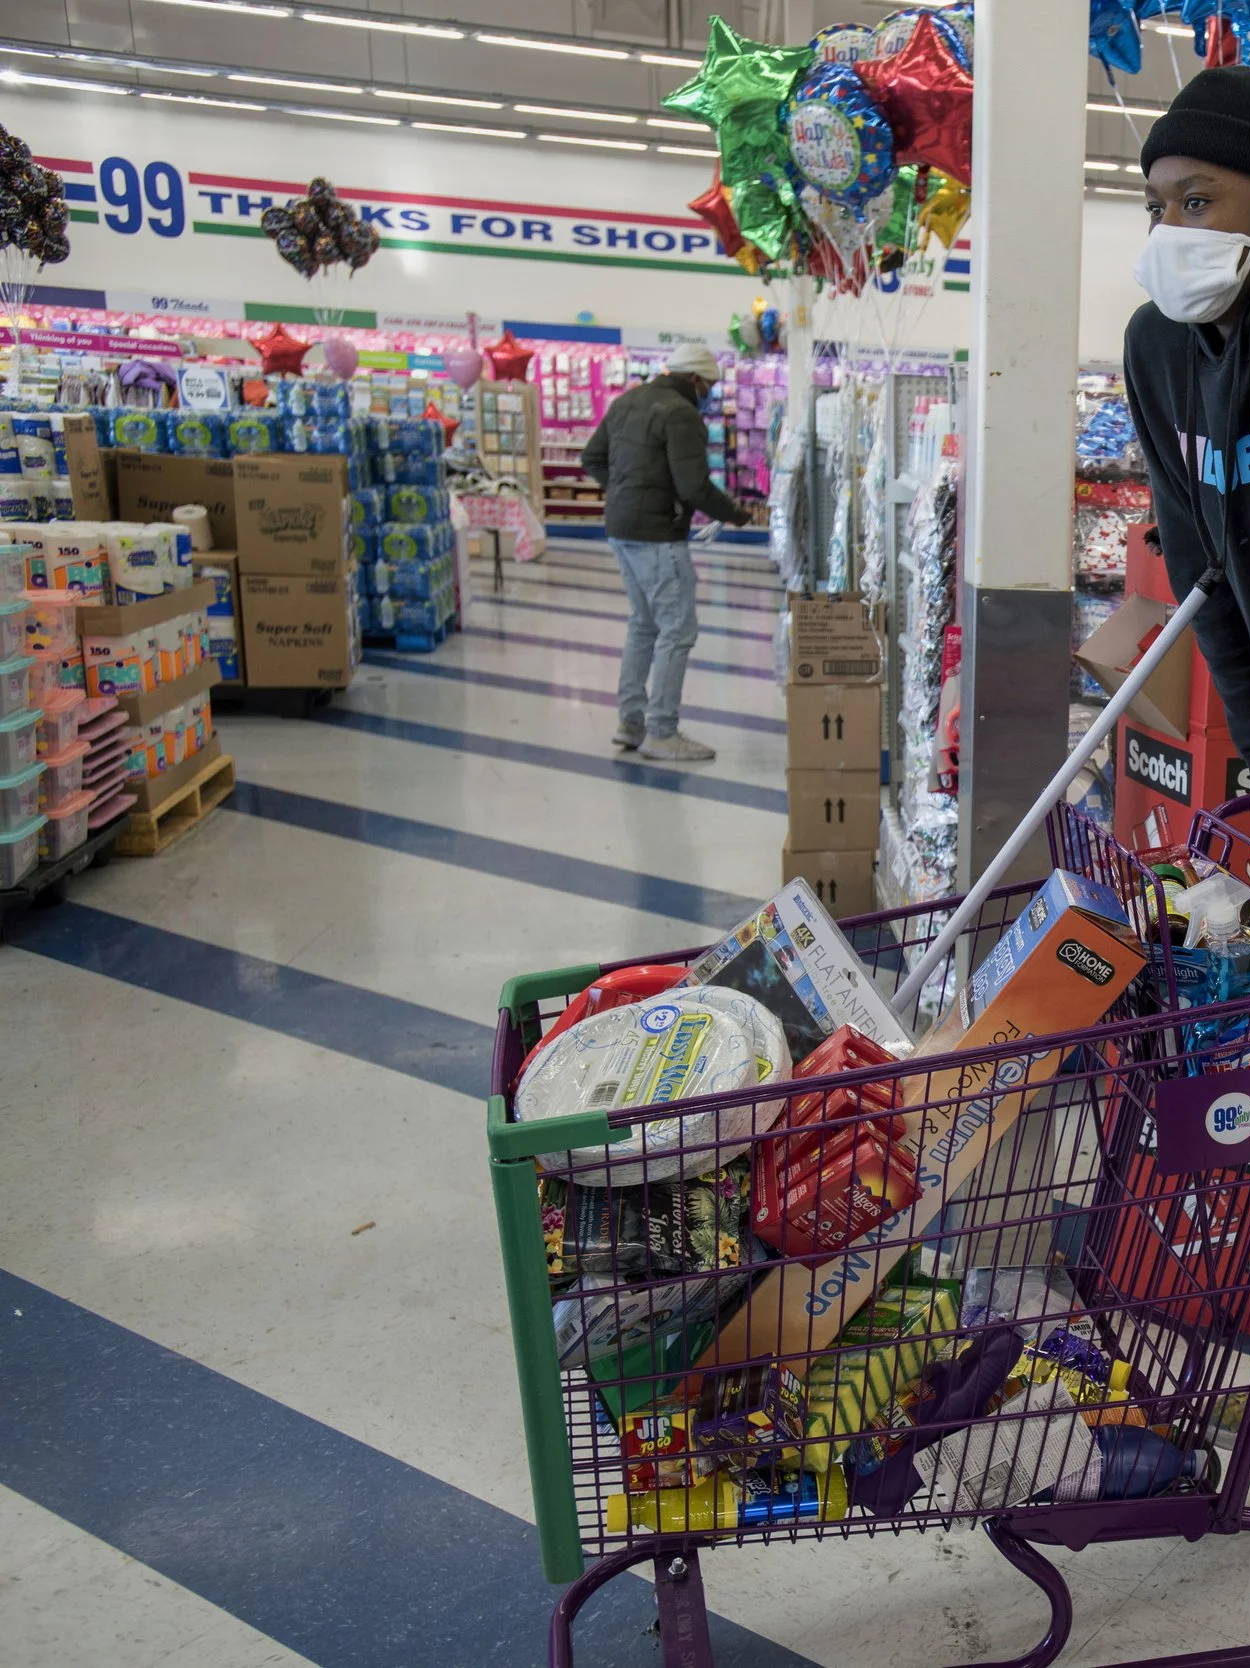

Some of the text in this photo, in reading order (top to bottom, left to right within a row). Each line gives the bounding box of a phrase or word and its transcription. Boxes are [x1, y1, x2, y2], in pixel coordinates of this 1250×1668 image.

[794, 120, 848, 147] Happy
[100, 157, 185, 238] 99
[198, 190, 430, 232] THKS
[450, 213, 553, 241] FOR
[30, 333, 92, 346] Thinking of you
[108, 339, 138, 350] Special
[137, 496, 174, 511] Supe
[58, 547, 80, 556] 150
[255, 622, 333, 635] Super Soft
[90, 647, 110, 656] 150
[267, 636, 325, 647] NAPKINS
[1128, 738, 1189, 796] Scotch
[796, 926, 815, 948] 4K
[808, 944, 845, 987] FLAT
[1074, 960, 1105, 983] FORMATION
[1078, 951, 1112, 979] HOME
[1173, 966, 1199, 979] light
[660, 1015, 708, 1063] Easy
[929, 1033, 1051, 1165] Premium
[1234, 1110, 1250, 1126] only
[843, 1183, 883, 1218] Folgers
[780, 1367, 801, 1396] Jif
[780, 1387, 798, 1405] TO GO
[636, 1416, 671, 1440] Jif
[640, 1436, 672, 1455] TO GO
[631, 1474, 638, 1483] 3
